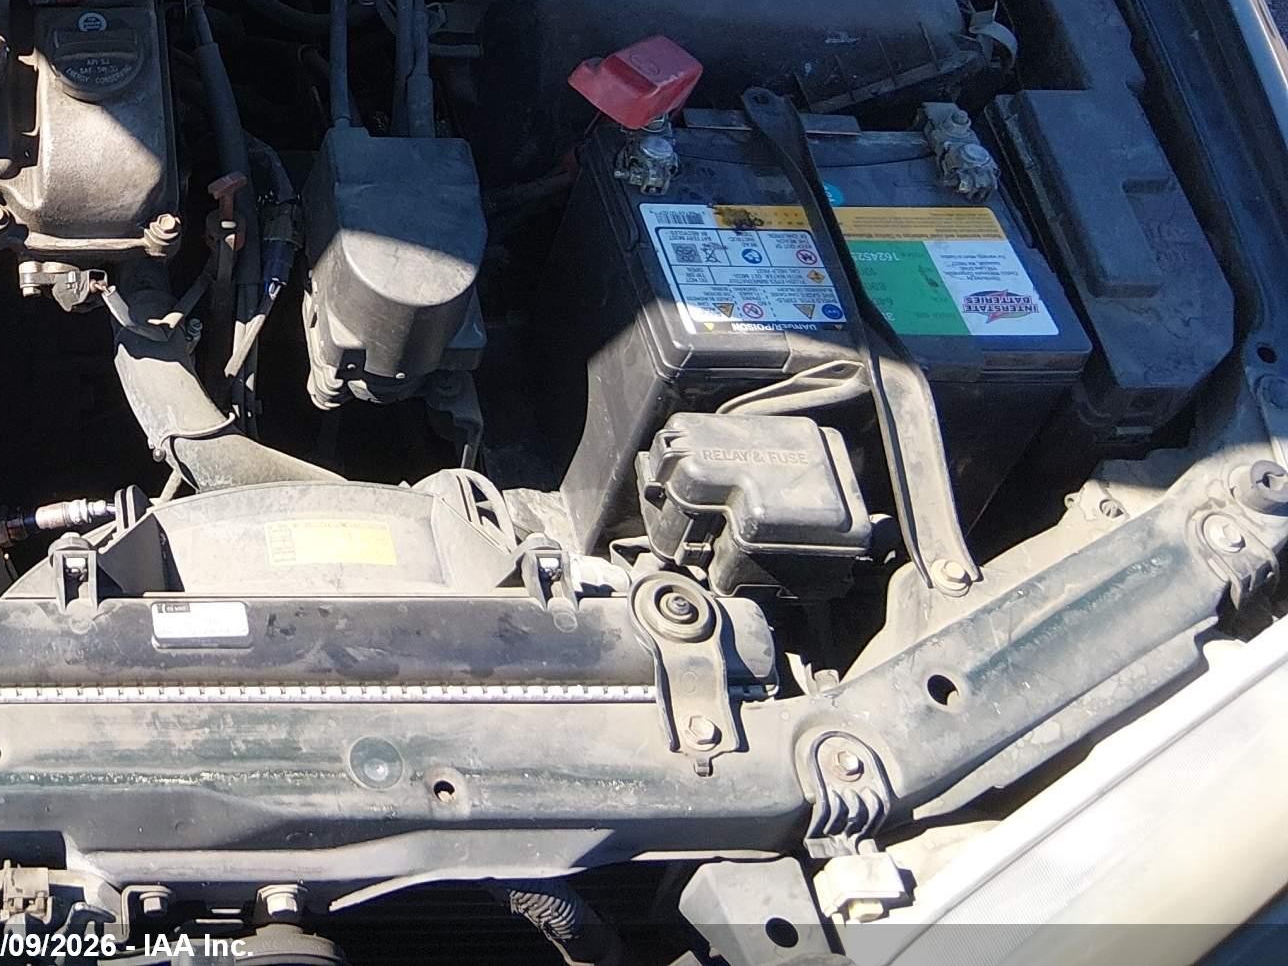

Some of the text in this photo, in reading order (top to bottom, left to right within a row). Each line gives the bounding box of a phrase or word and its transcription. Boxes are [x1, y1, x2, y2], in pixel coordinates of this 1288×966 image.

[966, 296, 1031, 304] BATTERIES
[965, 305, 1037, 313] INTERSTATE
[702, 449, 809, 465] RELAY & FUSE
